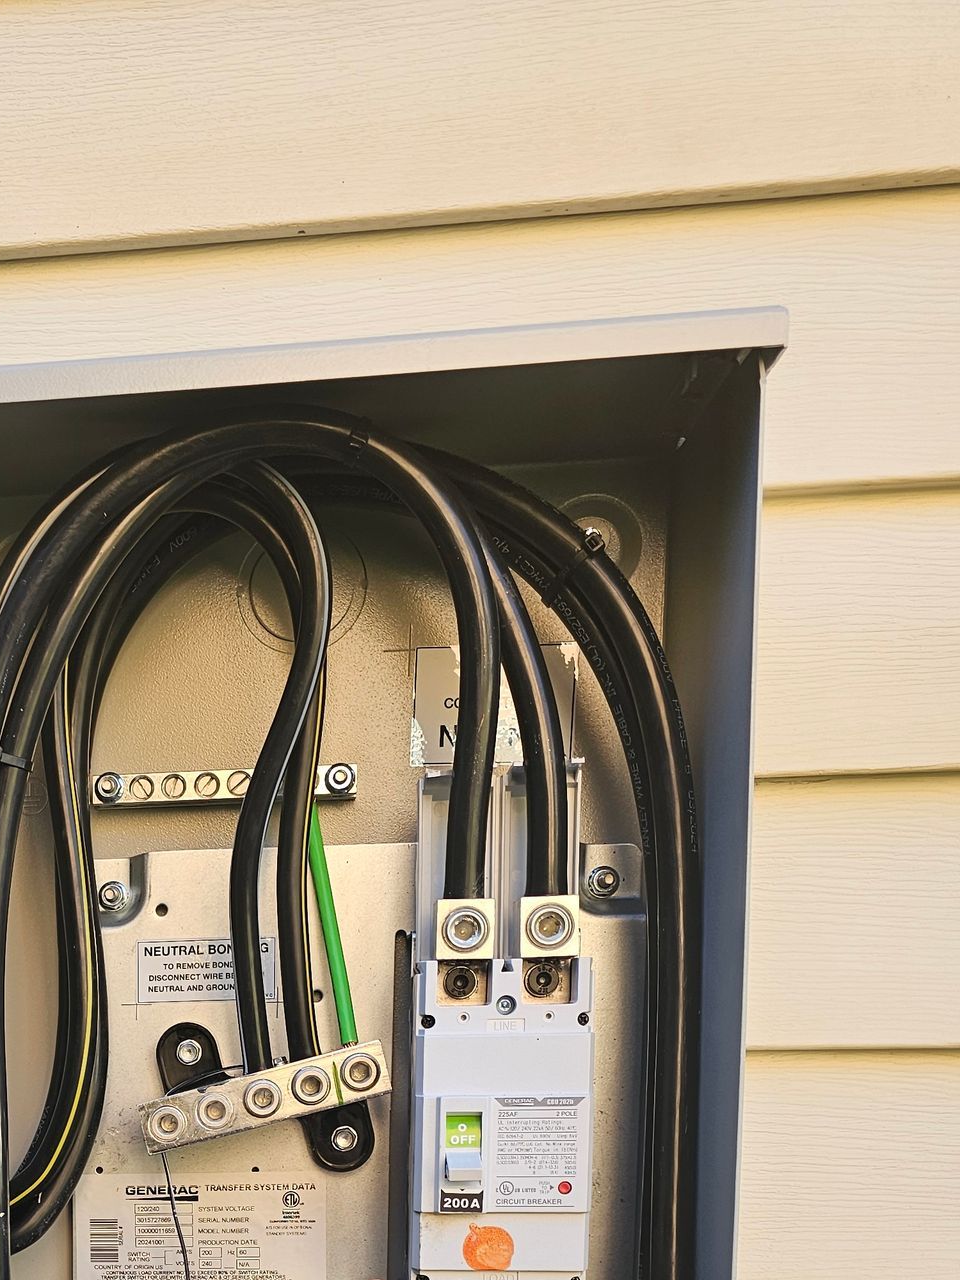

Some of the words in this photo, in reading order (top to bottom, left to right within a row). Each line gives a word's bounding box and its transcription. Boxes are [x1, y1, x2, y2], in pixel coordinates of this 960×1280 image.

[614, 704, 632, 747] CABLE
[144, 945, 204, 957] NEUTRAL
[176, 962, 211, 970] REMOVE
[148, 974, 201, 982] DISCONNECT
[148, 985, 185, 993] NEUTRAL
[493, 1020, 518, 1032] LINE
[450, 1135, 476, 1145] OFF
[125, 1184, 199, 1196] GENERAC
[205, 1184, 251, 1192] TRANSFER
[254, 1183, 289, 1191] SYSTEM
[291, 1183, 317, 1191] DATA
